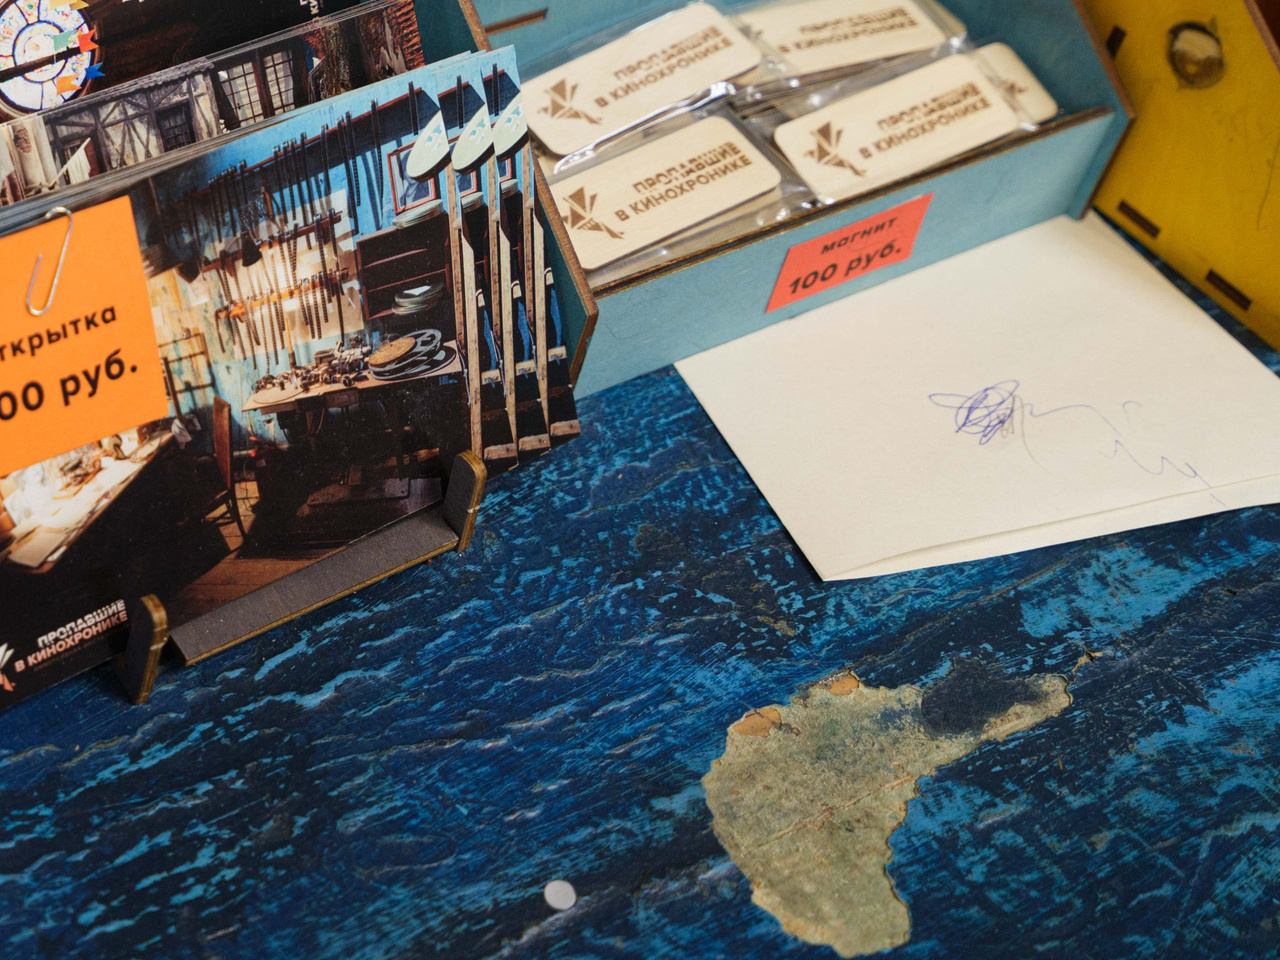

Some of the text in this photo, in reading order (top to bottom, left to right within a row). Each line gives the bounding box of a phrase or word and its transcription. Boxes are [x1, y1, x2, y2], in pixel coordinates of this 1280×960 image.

[594, 36, 733, 108] В КИНОХРОНИКЕ
[613, 25, 722, 80] ПРОПАВШИЕ
[873, 95, 992, 153] КИНОХРОНИКЕ
[614, 153, 753, 222] В КИНОХРОНИКЕ
[632, 140, 742, 194] ПРОПАВШИЕ
[821, 216, 897, 255] магнит
[789, 238, 902, 294] 100 руб.
[59, 348, 138, 407] руб.
[14, 659, 26, 673] В
[26, 609, 128, 667] КИНОХРОНИКЕ
[37, 598, 126, 649] ПРОПАВШИЕ
